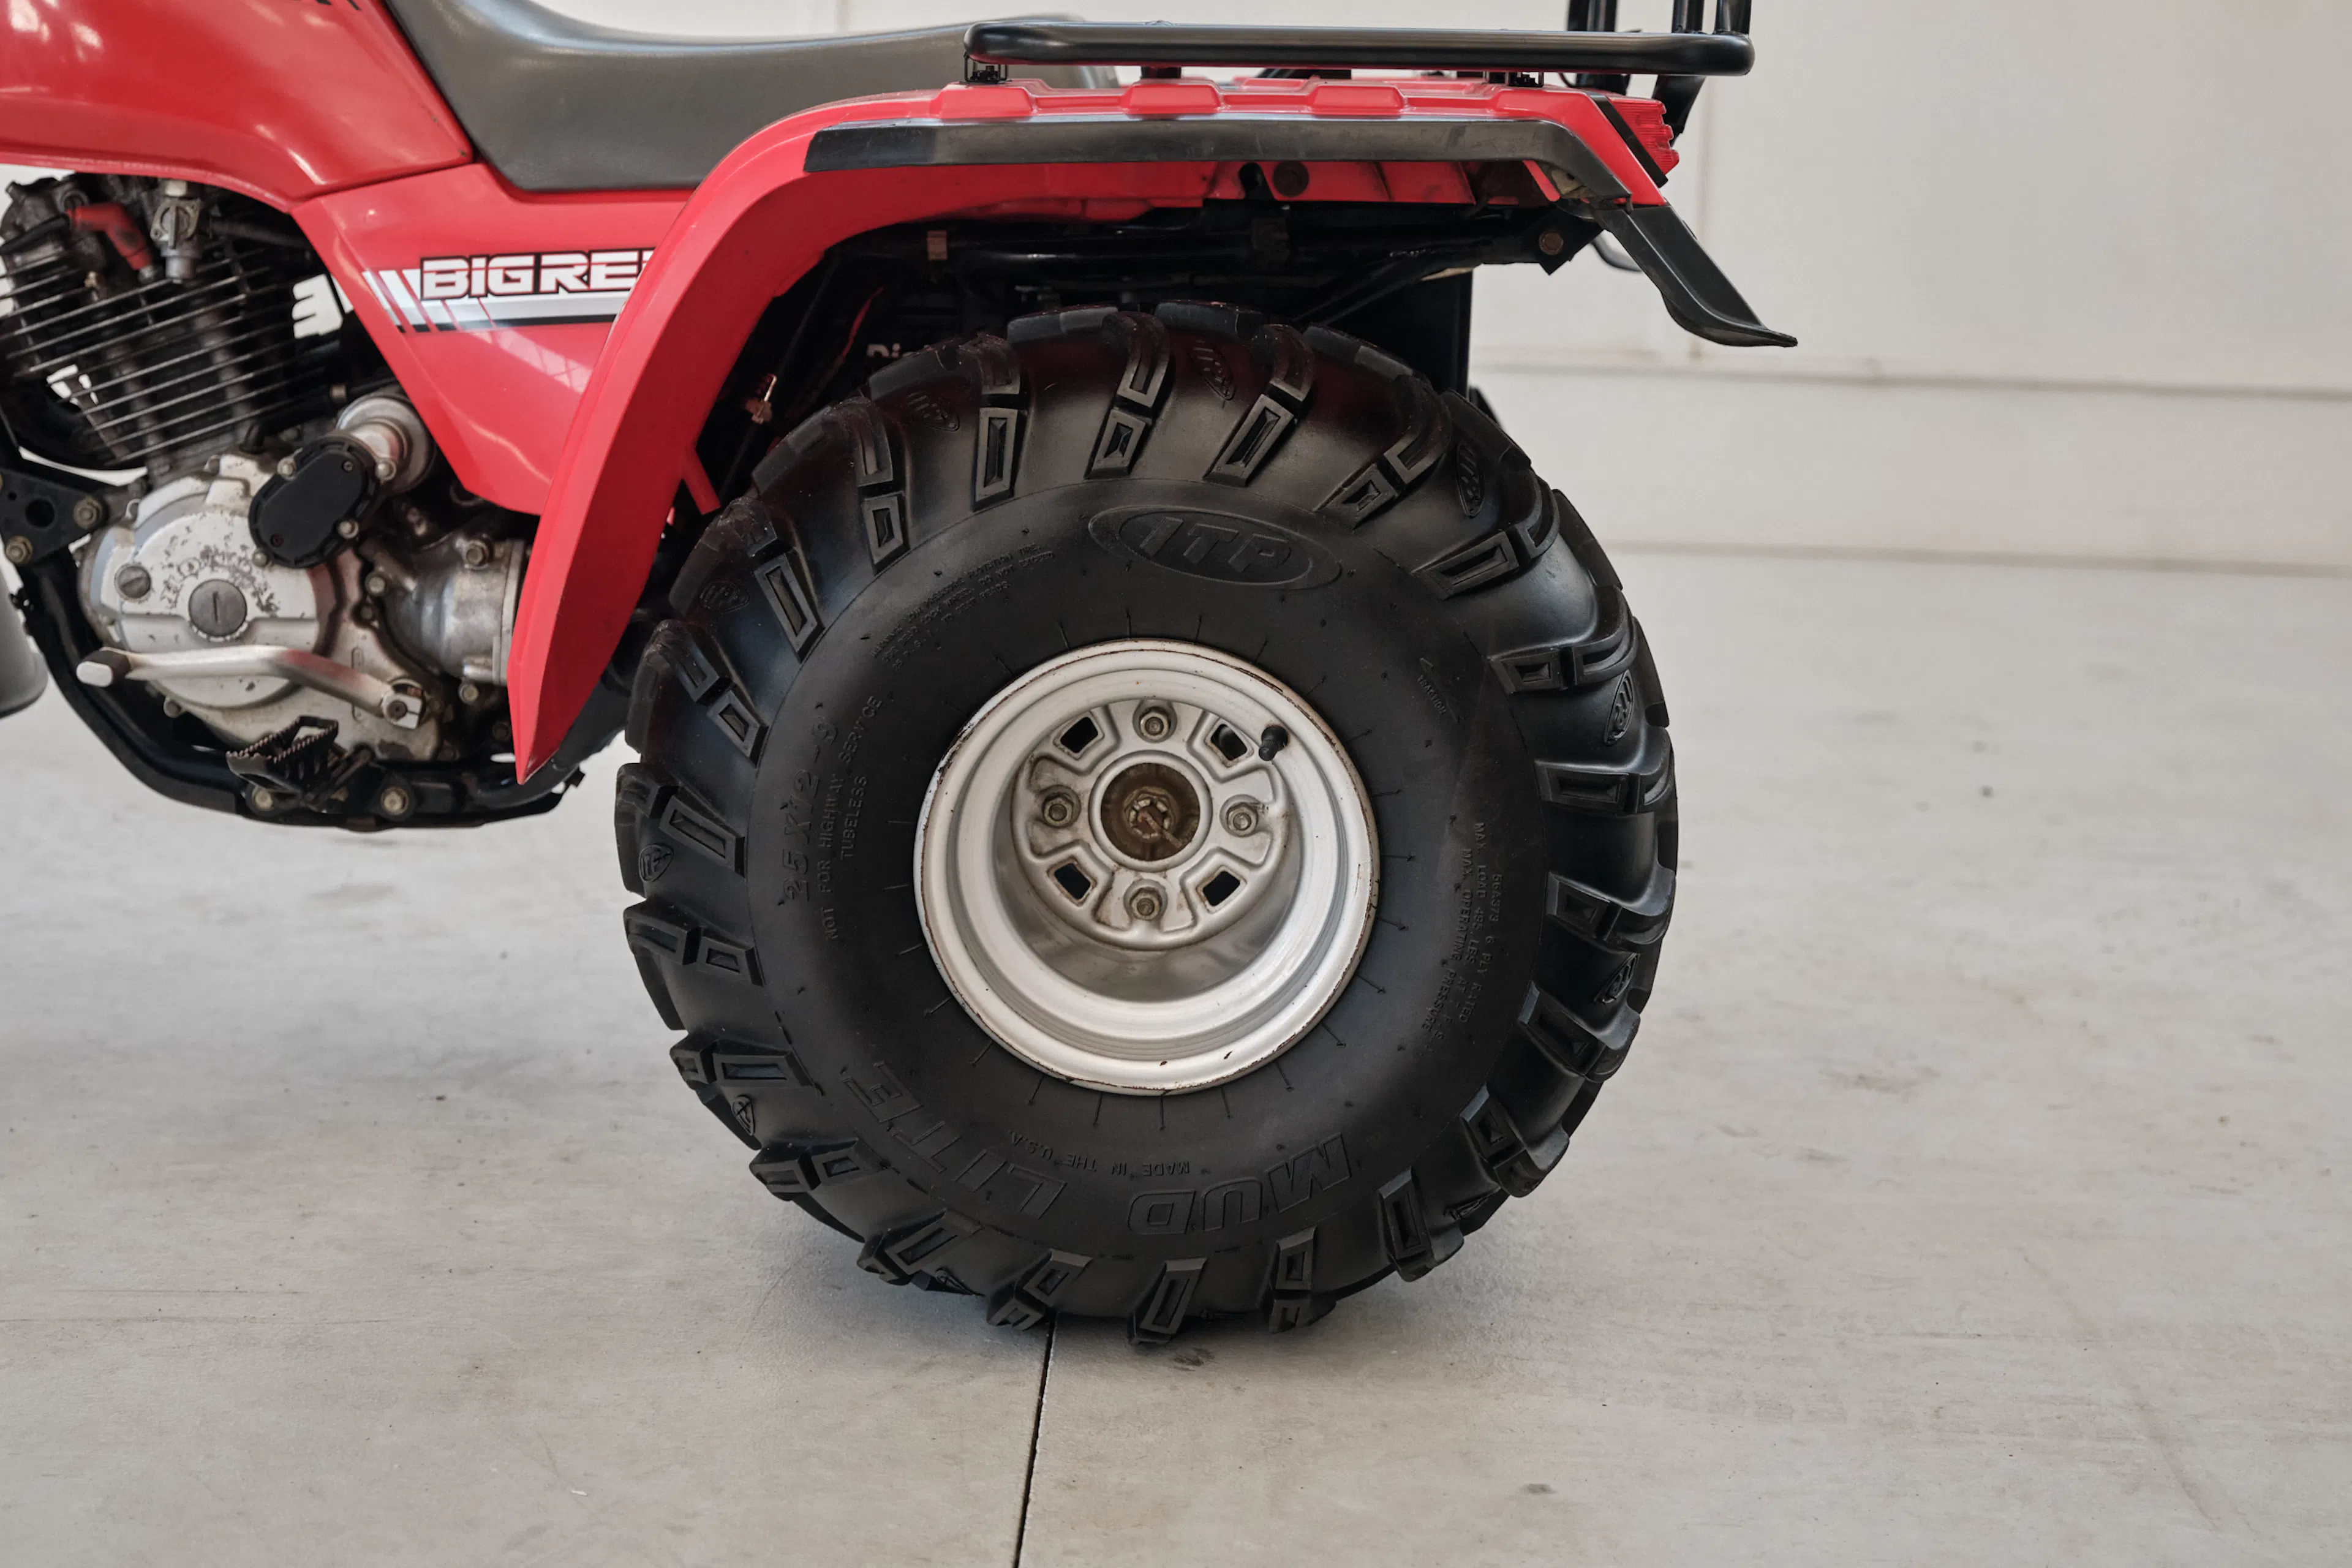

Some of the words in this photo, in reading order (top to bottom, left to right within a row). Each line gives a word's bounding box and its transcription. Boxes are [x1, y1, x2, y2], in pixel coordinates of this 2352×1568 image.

[421, 255, 535, 301] BIG
[537, 247, 657, 293] RE
[838, 695, 883, 765] SERVICE
[818, 774, 845, 848] HIGHWAY
[840, 774, 868, 861] TUBELESS
[816, 860, 834, 894] FOR
[1477, 864, 1487, 899] LOAD
[820, 907, 839, 940] NOT
[1450, 889, 1472, 961] OPERATING
[1422, 967, 1457, 1031] PRESSURE
[840, 1061, 1068, 1221] LITE
[1066, 1153, 1098, 1173] THE
[1111, 1161, 1128, 1176] IN
[1142, 1161, 1191, 1177] MADE
[1127, 1132, 1352, 1235] MUD
